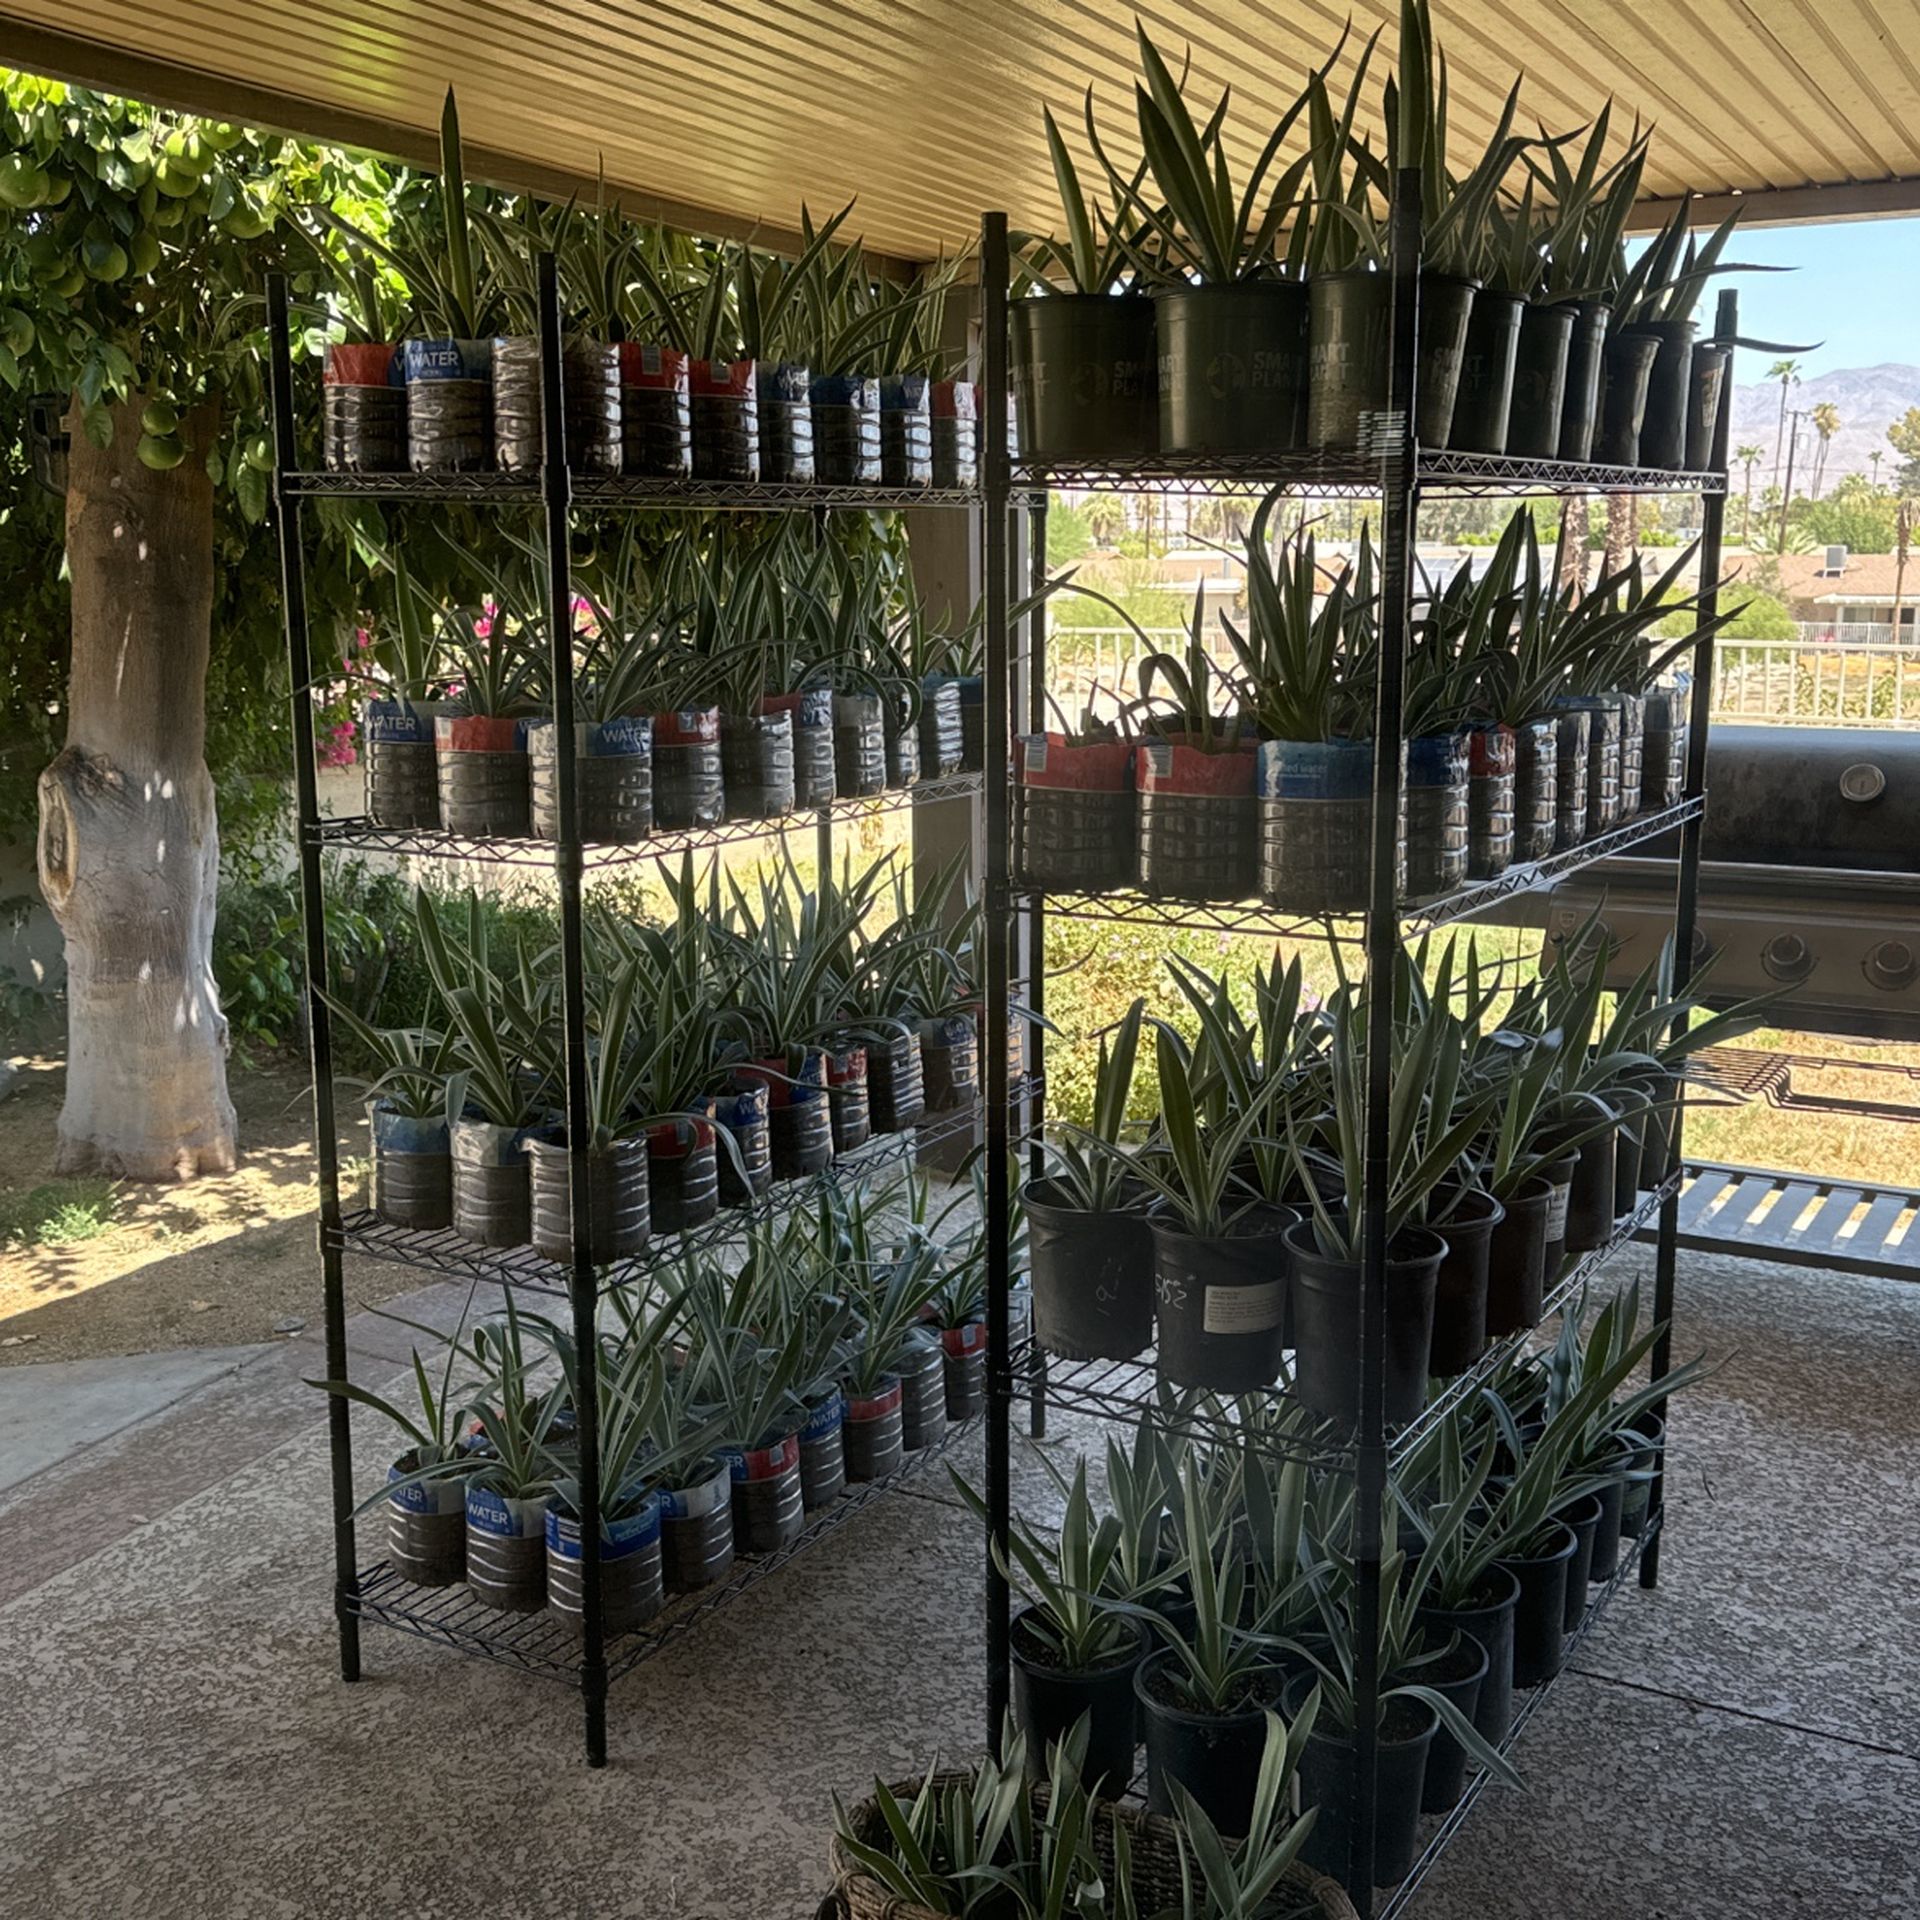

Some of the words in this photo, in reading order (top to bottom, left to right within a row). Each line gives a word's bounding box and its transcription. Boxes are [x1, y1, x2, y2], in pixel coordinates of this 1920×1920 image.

[409, 351, 459, 367] WATER
[602, 727, 648, 743] WATE
[398, 1487, 423, 1503] ATER
[469, 1503, 508, 1525] WATER
